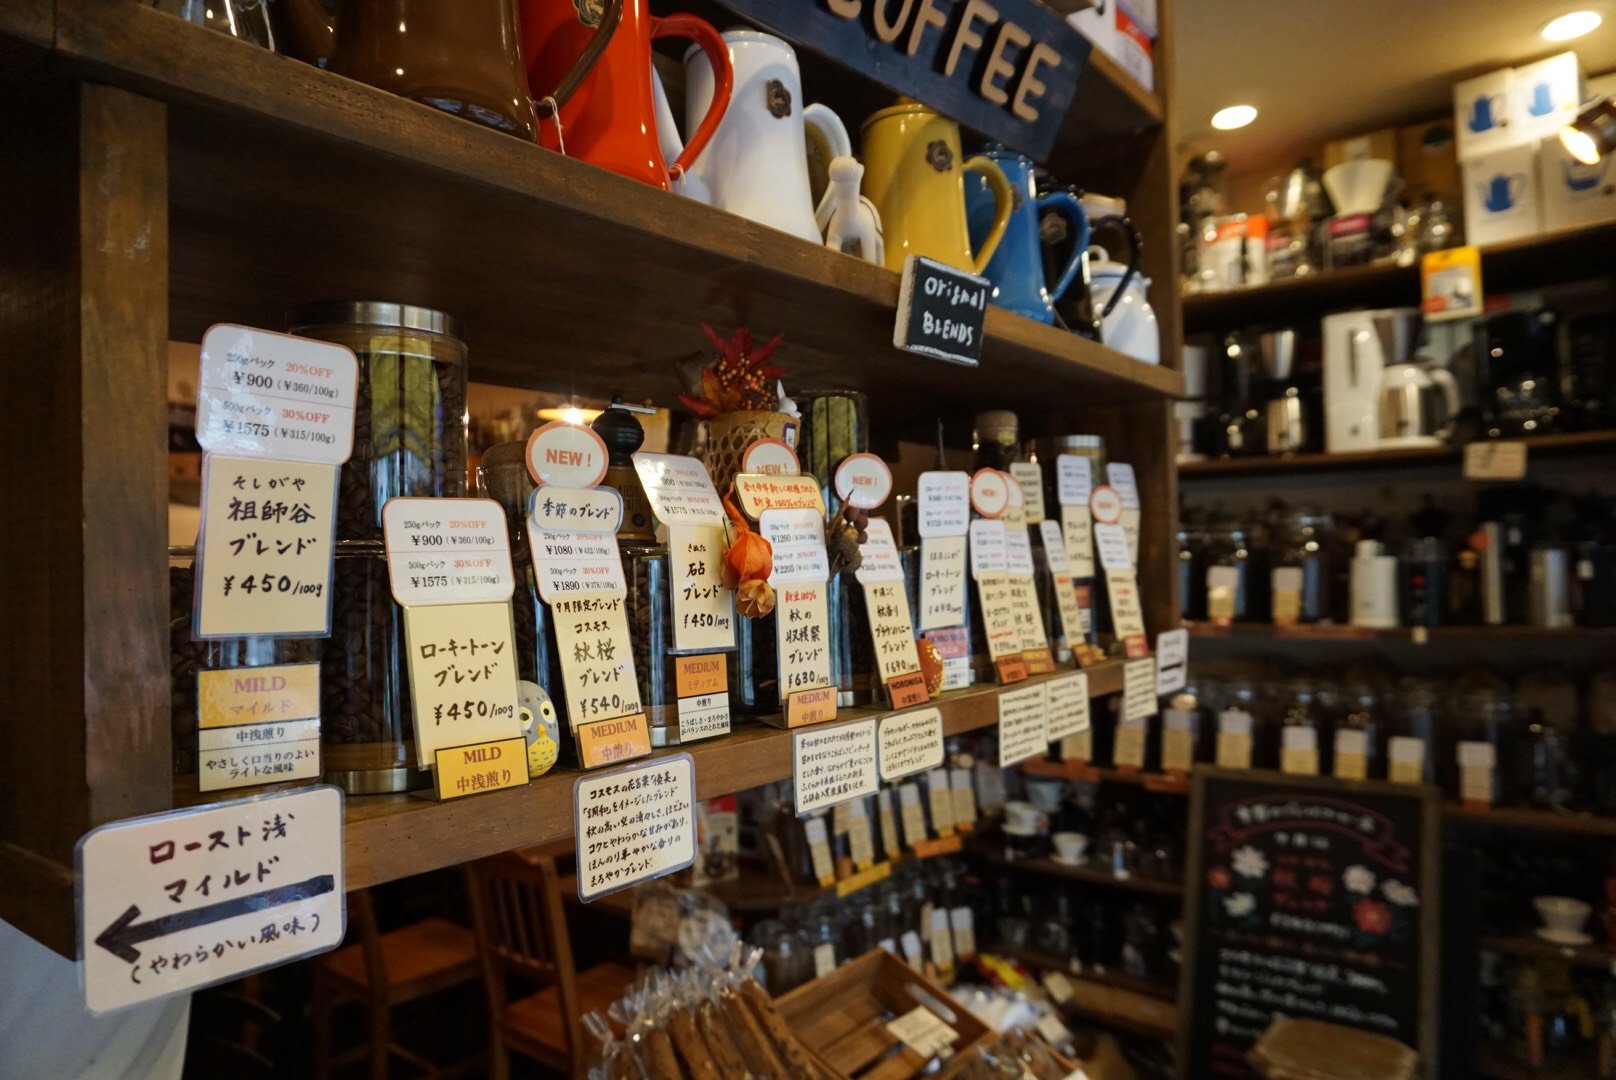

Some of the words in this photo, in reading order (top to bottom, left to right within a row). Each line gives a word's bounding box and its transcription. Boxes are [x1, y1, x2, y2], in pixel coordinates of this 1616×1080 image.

[922, 311, 974, 347] BLENDS
[227, 353, 275, 368] 250gパック
[285, 363, 334, 378] 20%OFF
[233, 371, 273, 388] ¥900
[278, 380, 339, 398] (¥360/100g)
[281, 408, 330, 424] 30%OFF
[223, 419, 269, 437] ¥1575
[274, 427, 335, 445] (¥315/100g)
[232, 475, 306, 491] そしがや
[227, 497, 316, 524] 祖師谷
[542, 497, 614, 519] 季節のブレンド
[403, 520, 441, 530] 250gパック
[449, 520, 487, 529] 20%OFF
[229, 532, 317, 556] ブレンド
[411, 535, 443, 546] ¥900
[545, 545, 573, 555] ¥1080
[408, 560, 445, 570] 500gパック
[454, 559, 492, 568] 30%OFF
[223, 574, 323, 597] ¥450/100g
[410, 576, 448, 588] ¥1575
[552, 581, 580, 591] ¥1890
[683, 582, 723, 601] ブレンド
[556, 598, 621, 613] 9月限定ブレンド
[574, 620, 610, 634] コスモス
[420, 638, 505, 660] ローキートーン
[573, 638, 616, 663] 秋桜
[788, 648, 823, 664] ブレンド
[882, 640, 909, 654] ブレンド
[434, 662, 498, 687] ブレンド
[580, 665, 624, 687] ブレンド
[683, 661, 720, 675] MEDIUM
[234, 676, 287, 694] MILD
[796, 691, 830, 705] MEDIUM
[229, 700, 292, 716] マイルド
[434, 700, 514, 726] ¥450/100g
[236, 727, 285, 743] 中浅煎り
[591, 720, 638, 739] MEDIUM
[206, 749, 315, 770] やさしく口当りのよい
[463, 746, 502, 765] MILD
[229, 762, 294, 779] ライトな風味
[456, 769, 512, 792] 中浅煎り
[164, 856, 279, 903] マイルド
